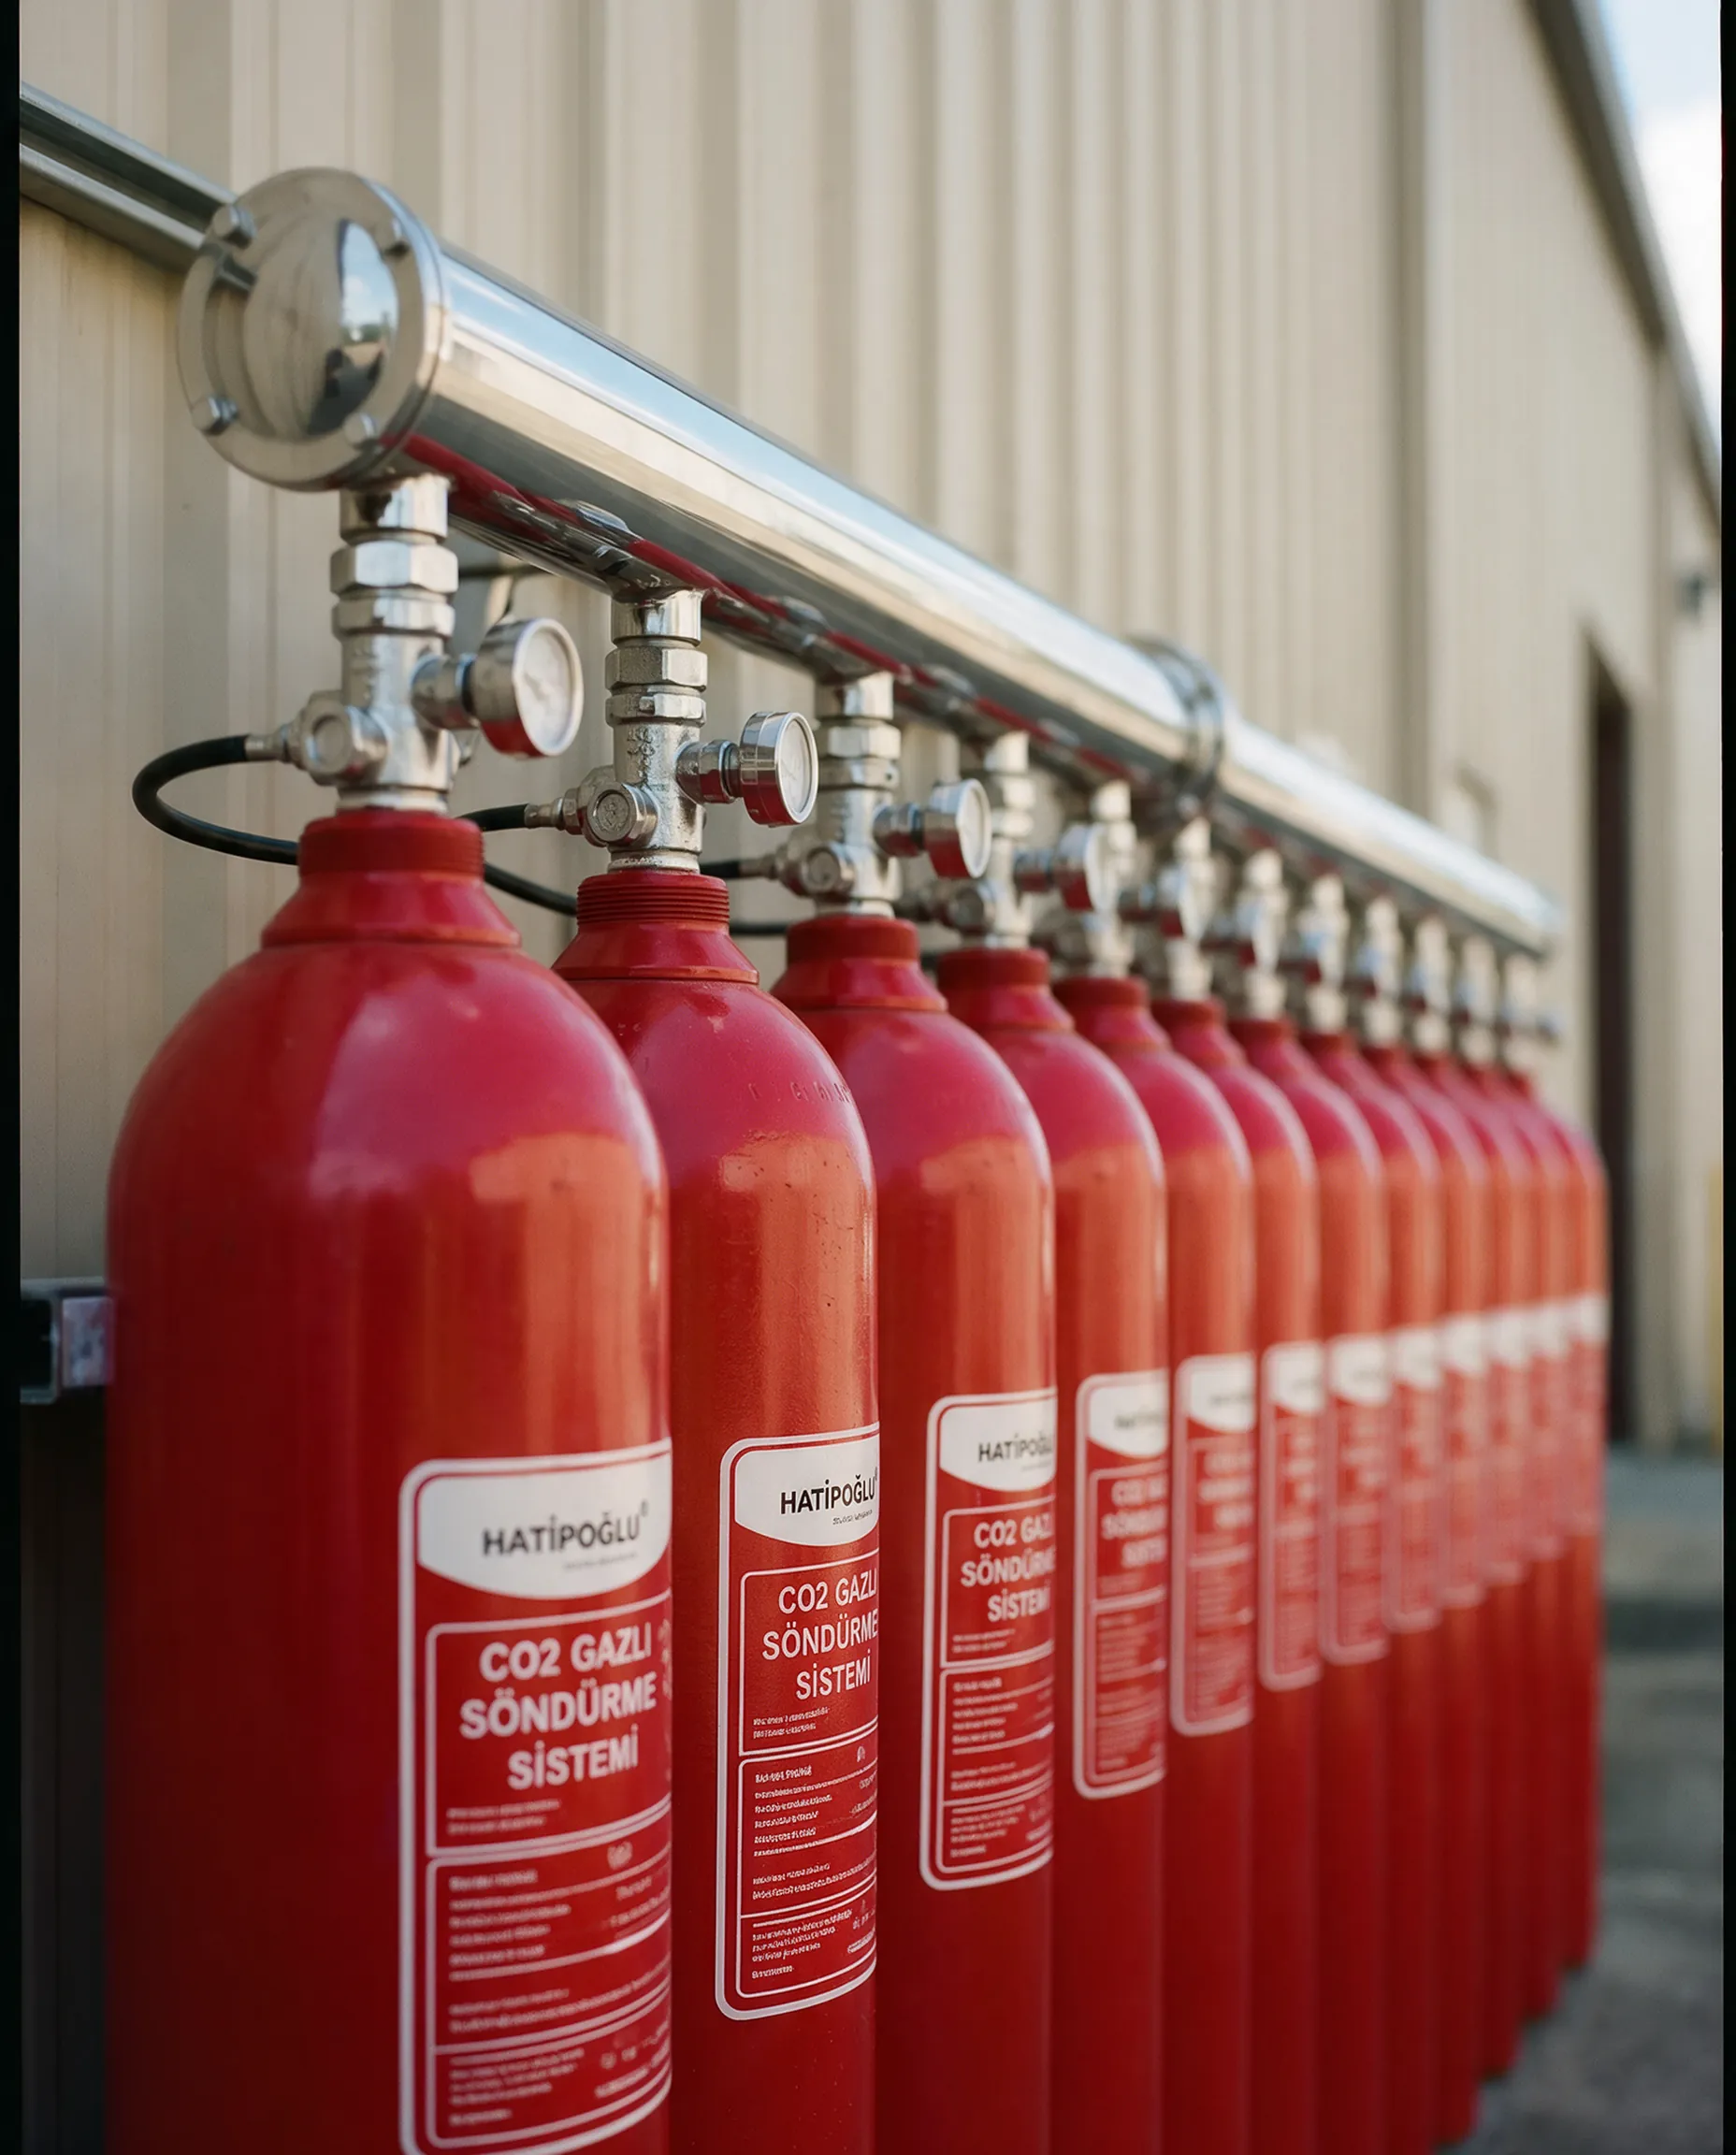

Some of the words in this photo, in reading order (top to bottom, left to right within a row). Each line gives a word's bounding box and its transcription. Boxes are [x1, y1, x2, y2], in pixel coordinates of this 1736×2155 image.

[780, 1474, 875, 1515] HATİPOĞLU
[482, 1511, 641, 1557] HATİPOĞLU
[974, 1519, 1018, 1549] CO2
[778, 1581, 829, 1614] CO2
[835, 1568, 877, 1607] GAZLI
[479, 1637, 561, 1683] CO2
[571, 1622, 652, 1673] GAZLI
[762, 1608, 879, 1661] SÖNDÜRME
[796, 1648, 872, 1700] SİSTEMİ
[458, 1670, 658, 1741] SÖNDÜRME
[506, 1723, 640, 1791] SİSTEMİ
